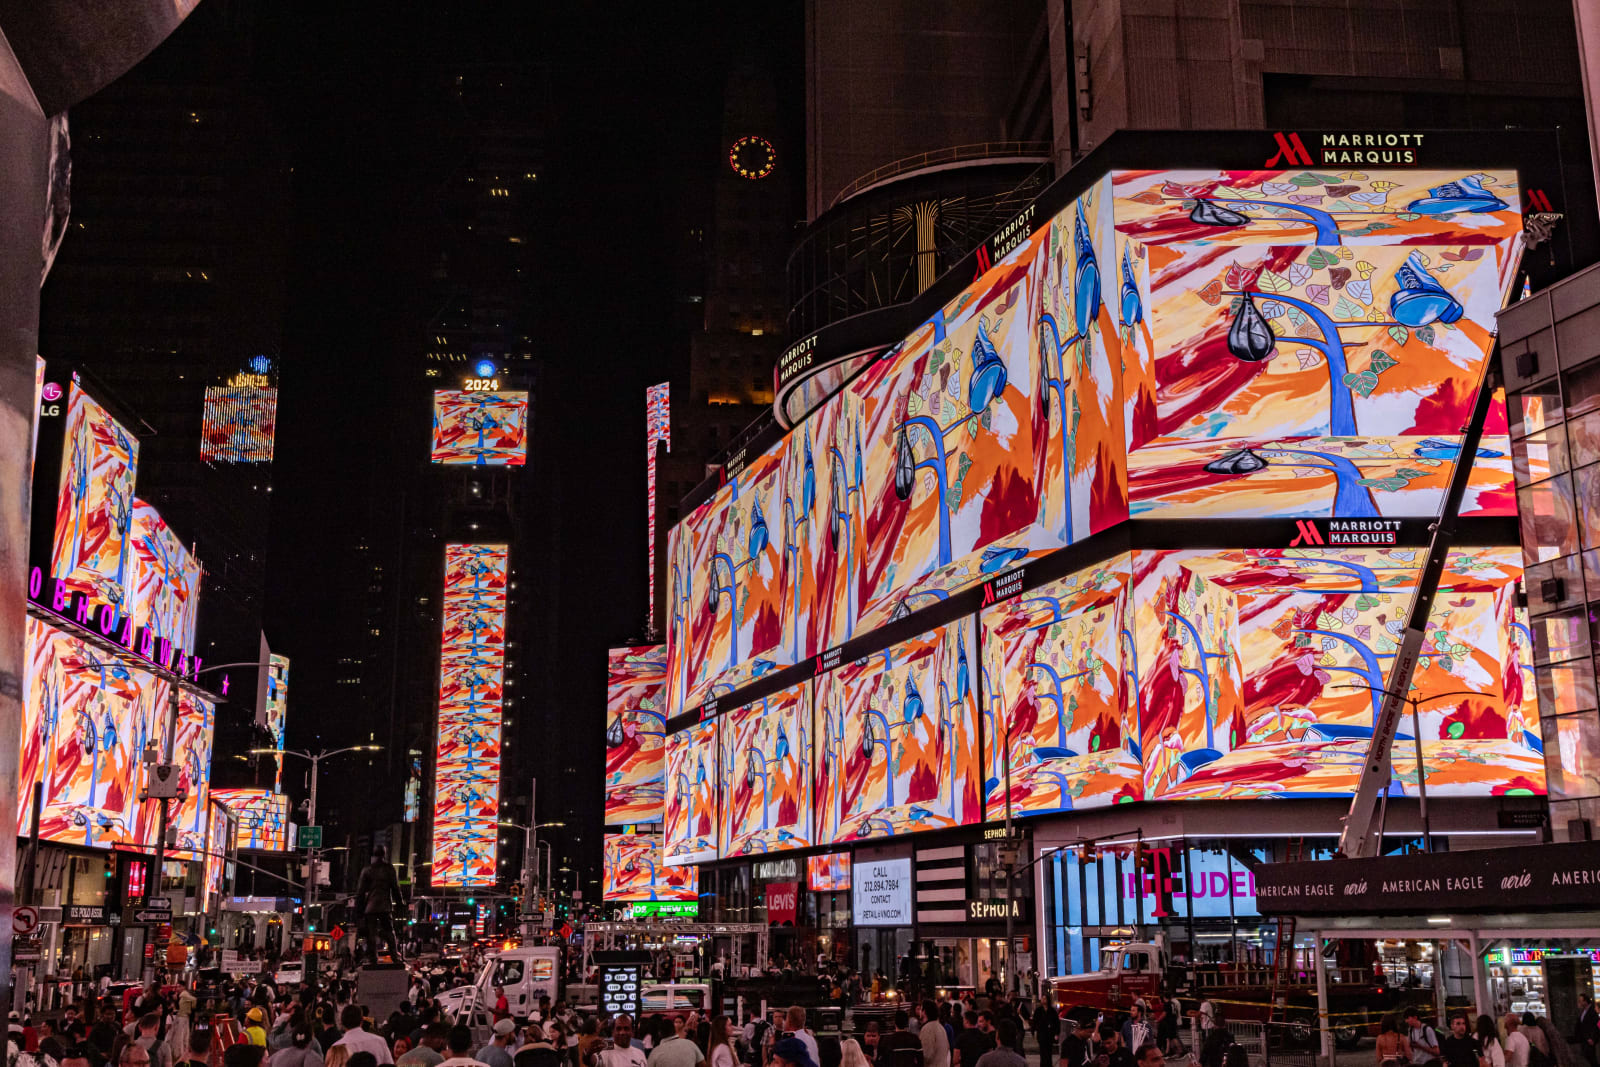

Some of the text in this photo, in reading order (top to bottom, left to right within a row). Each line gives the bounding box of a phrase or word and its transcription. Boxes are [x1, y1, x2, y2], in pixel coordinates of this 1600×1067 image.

[1322, 133, 1424, 146] MARRIOTT
[1324, 150, 1414, 163] MARQUIS
[994, 204, 1036, 247] MARRIOTT
[994, 224, 1031, 262] MARQUIS
[781, 335, 818, 368] MARRIOTT
[781, 353, 812, 384] MARQUIS
[464, 379, 499, 391] 2024
[40, 404, 60, 417] LG
[1329, 520, 1402, 531] MARRIOTT
[1331, 533, 1394, 543] MARQUIS
[996, 568, 1025, 588] MARRIOTT
[996, 581, 1022, 599] MARQUIS
[984, 827, 1007, 840] SEPHOR
[873, 866, 888, 877] CALL
[864, 879, 899, 892] 212.894.7984
[1255, 885, 1300, 897] AMERICAN
[1305, 884, 1334, 896] EAGLE
[1344, 878, 1368, 896] aerie
[1382, 878, 1440, 893] AMERICAN
[1447, 876, 1484, 891] EAGLE
[1501, 869, 1532, 890] aerie
[870, 894, 891, 904] CONTACT
[79, 907, 91, 918] POLO
[660, 905, 681, 913] NEW
